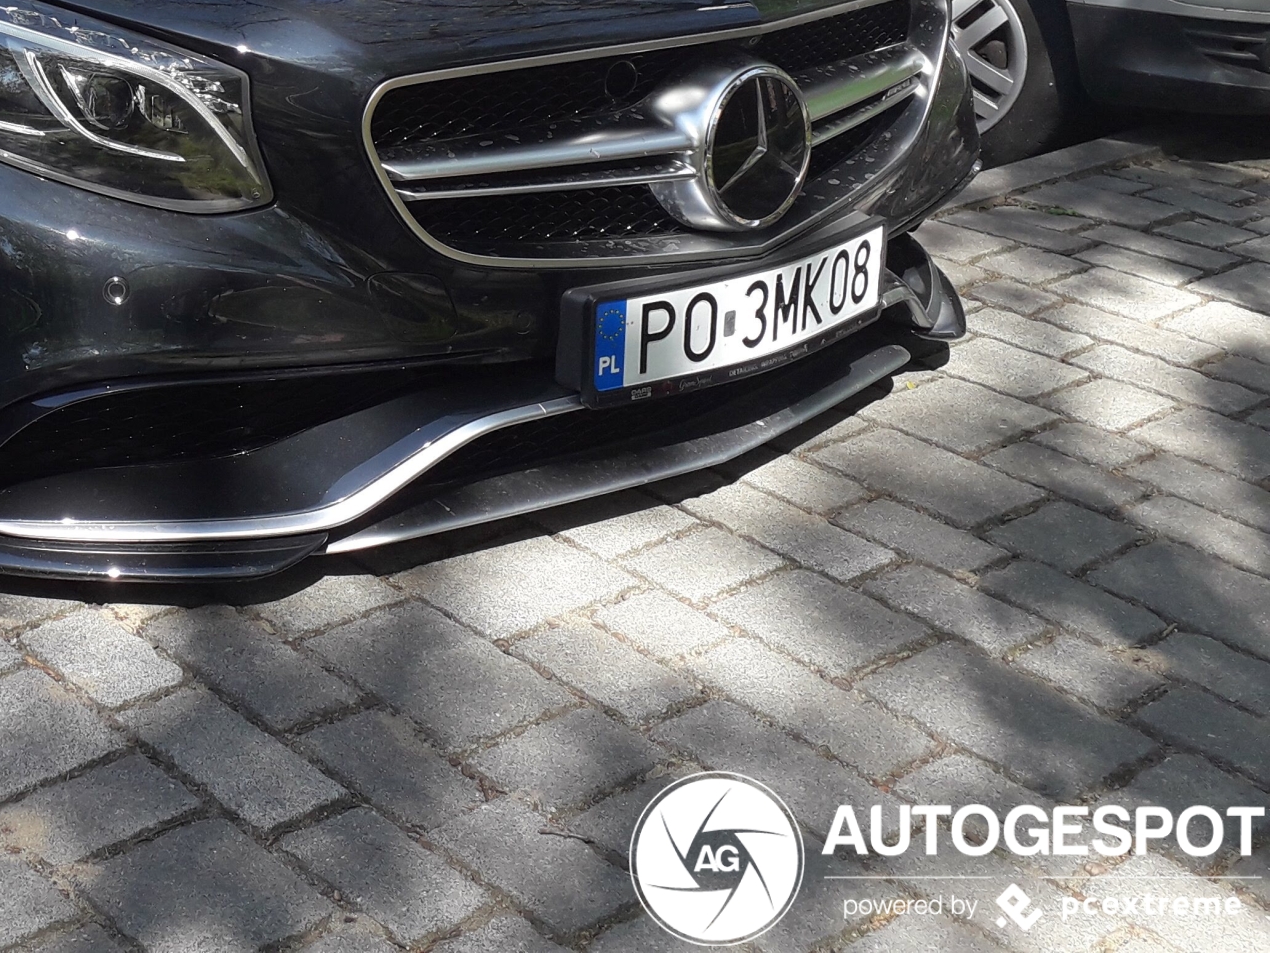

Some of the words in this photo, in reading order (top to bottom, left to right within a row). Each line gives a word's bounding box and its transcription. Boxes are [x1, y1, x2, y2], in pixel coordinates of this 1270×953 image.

[639, 291, 718, 375] PO
[741, 239, 871, 349] 3MK08
[598, 356, 620, 376] PL
